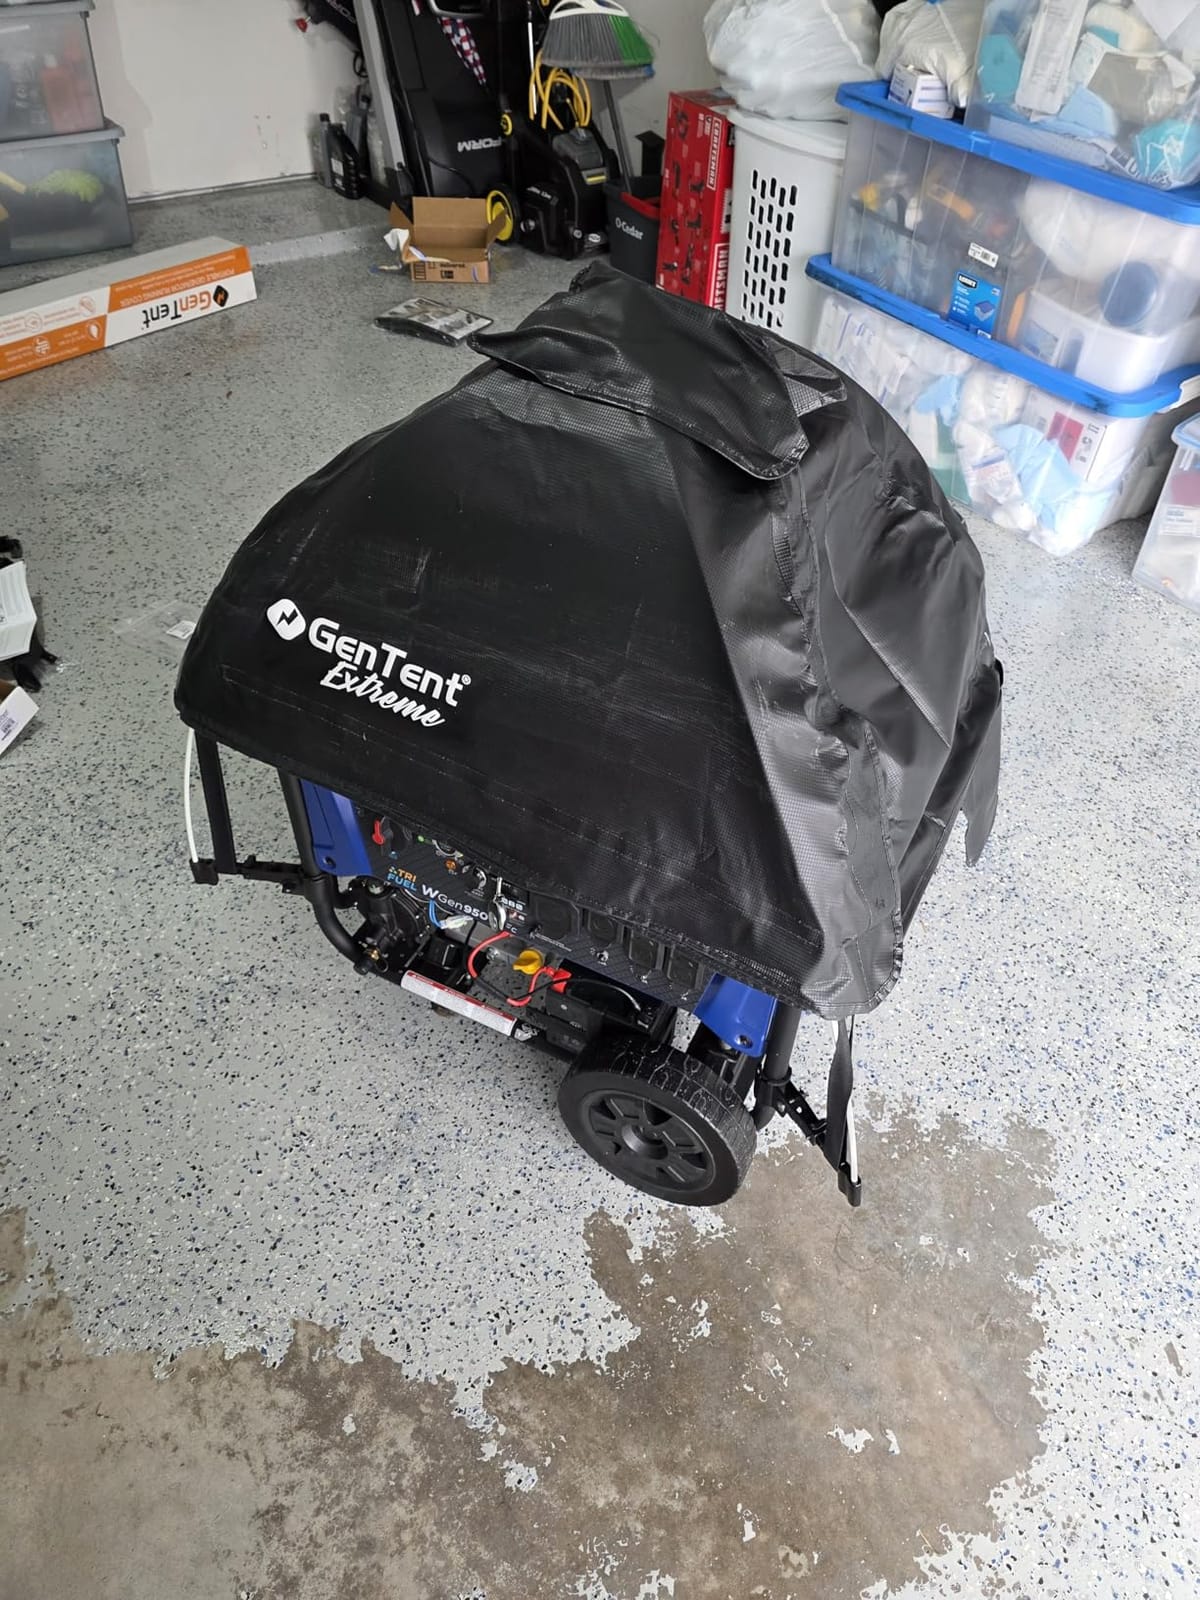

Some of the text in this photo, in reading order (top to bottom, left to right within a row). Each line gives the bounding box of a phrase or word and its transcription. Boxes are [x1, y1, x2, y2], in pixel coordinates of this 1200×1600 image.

[708, 121, 721, 189] CRAFTSMAN
[142, 290, 212, 328] GenTent
[320, 661, 446, 727] Extreme
[386, 873, 417, 892] FUEL
[397, 868, 417, 882] TRI
